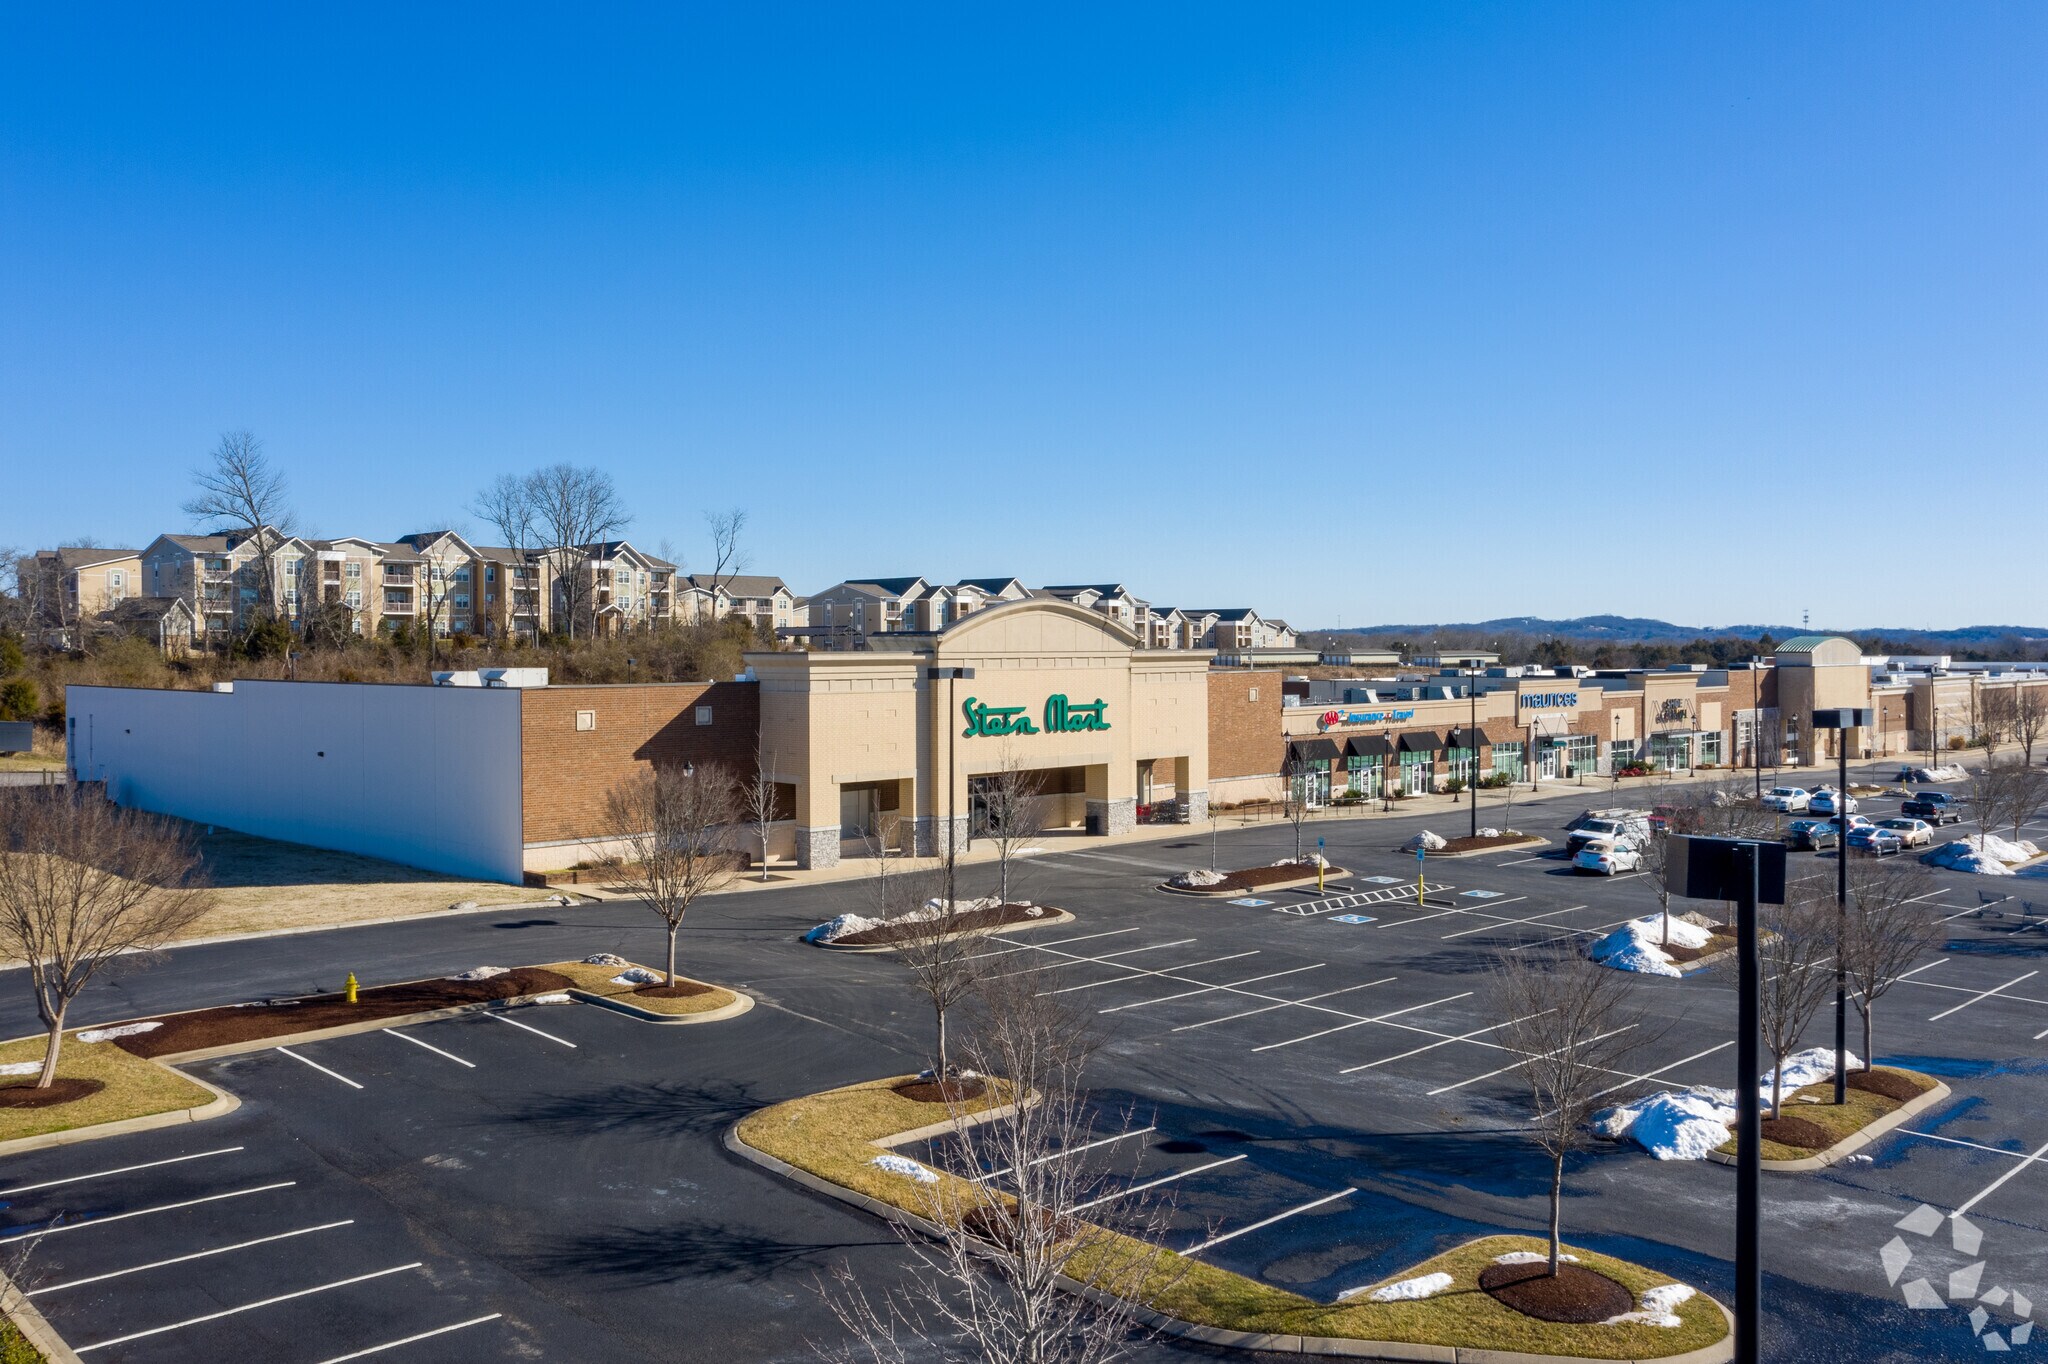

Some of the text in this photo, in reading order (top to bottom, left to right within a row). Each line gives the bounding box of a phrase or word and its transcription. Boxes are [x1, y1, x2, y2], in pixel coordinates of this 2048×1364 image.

[1521, 692, 1577, 708] maurices
[964, 694, 1111, 738] Stein Mart
[1348, 711, 1385, 722] Insurance
[1392, 708, 1414, 720] Travel
